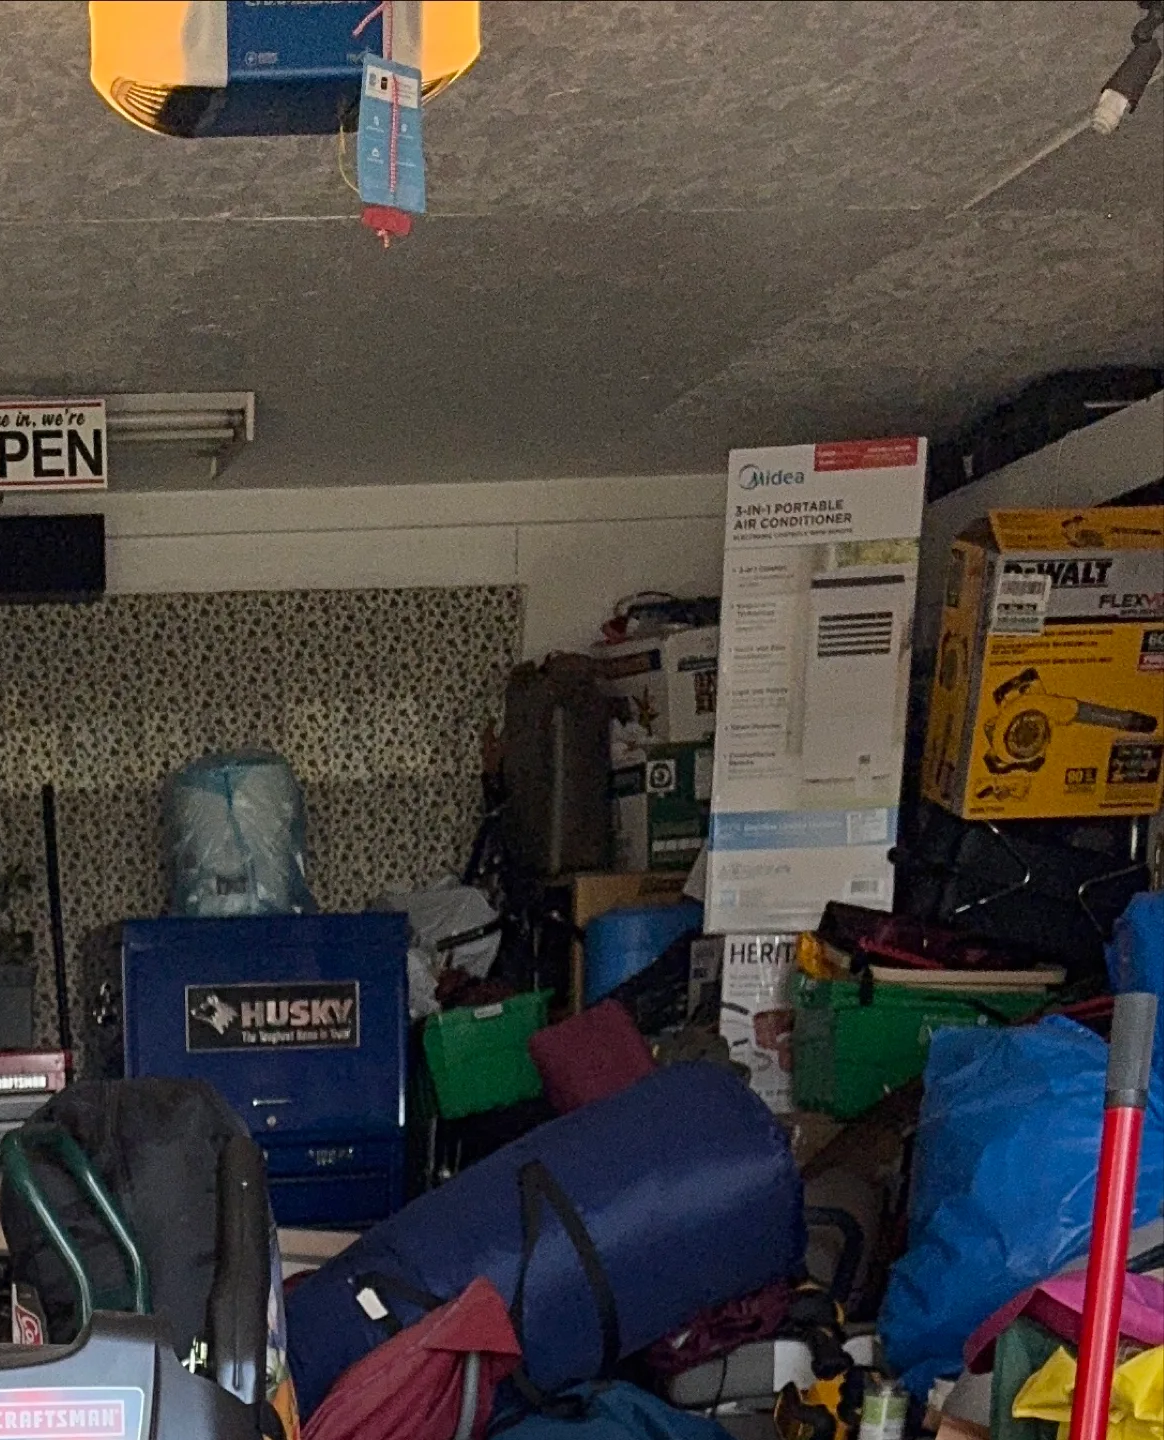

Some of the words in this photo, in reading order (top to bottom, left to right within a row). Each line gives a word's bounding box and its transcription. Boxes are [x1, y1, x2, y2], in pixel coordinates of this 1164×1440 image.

[15, 411, 36, 428] in,
[42, 408, 86, 427] we're
[742, 466, 805, 489] Midea
[735, 504, 771, 517] 3-IN-1
[774, 499, 845, 515] PORTABLE
[733, 518, 757, 531] AIR
[760, 511, 853, 529] CONDITIONER
[240, 999, 354, 1028] HUSKY
